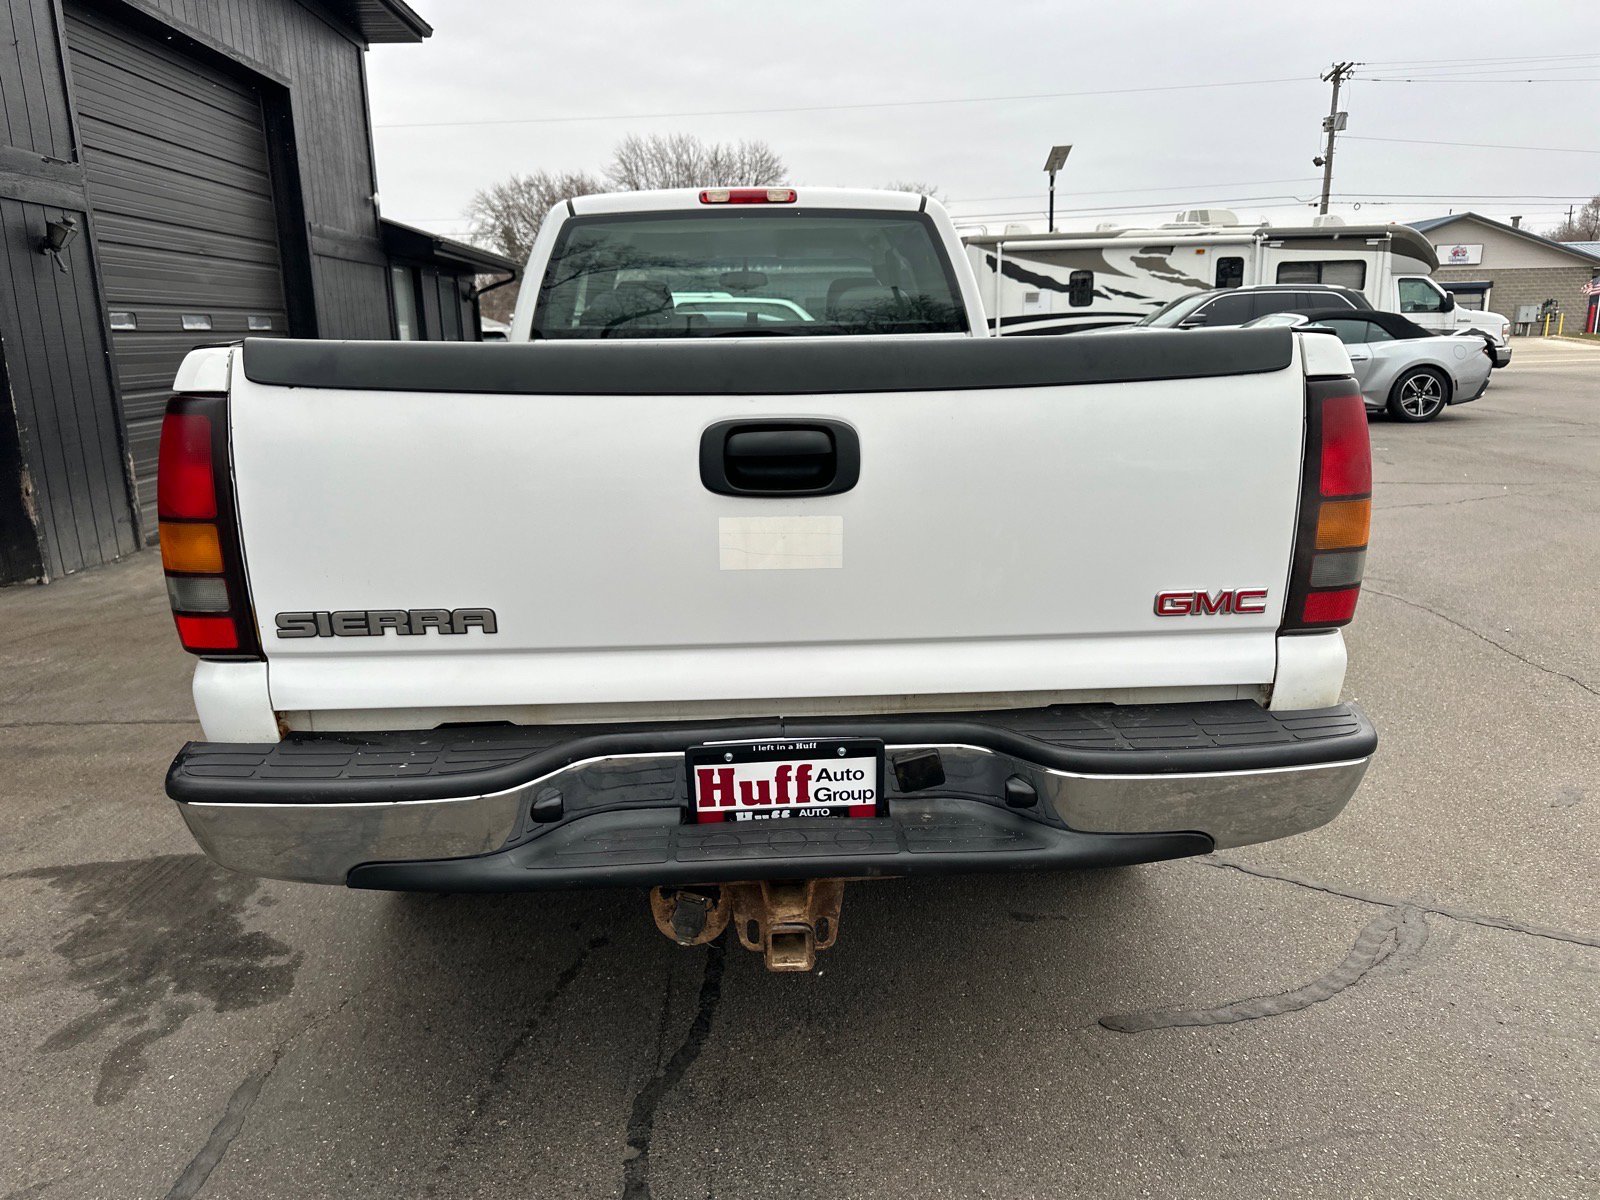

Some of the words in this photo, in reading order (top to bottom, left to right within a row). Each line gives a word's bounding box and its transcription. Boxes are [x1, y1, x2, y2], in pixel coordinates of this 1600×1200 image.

[1153, 587, 1269, 617] GMC
[275, 607, 498, 639] SIERRA
[795, 742, 817, 750] Huff
[697, 764, 813, 807] Huff
[815, 768, 864, 782] Auto
[814, 787, 874, 803] Group
[798, 808, 830, 817] AUTO
